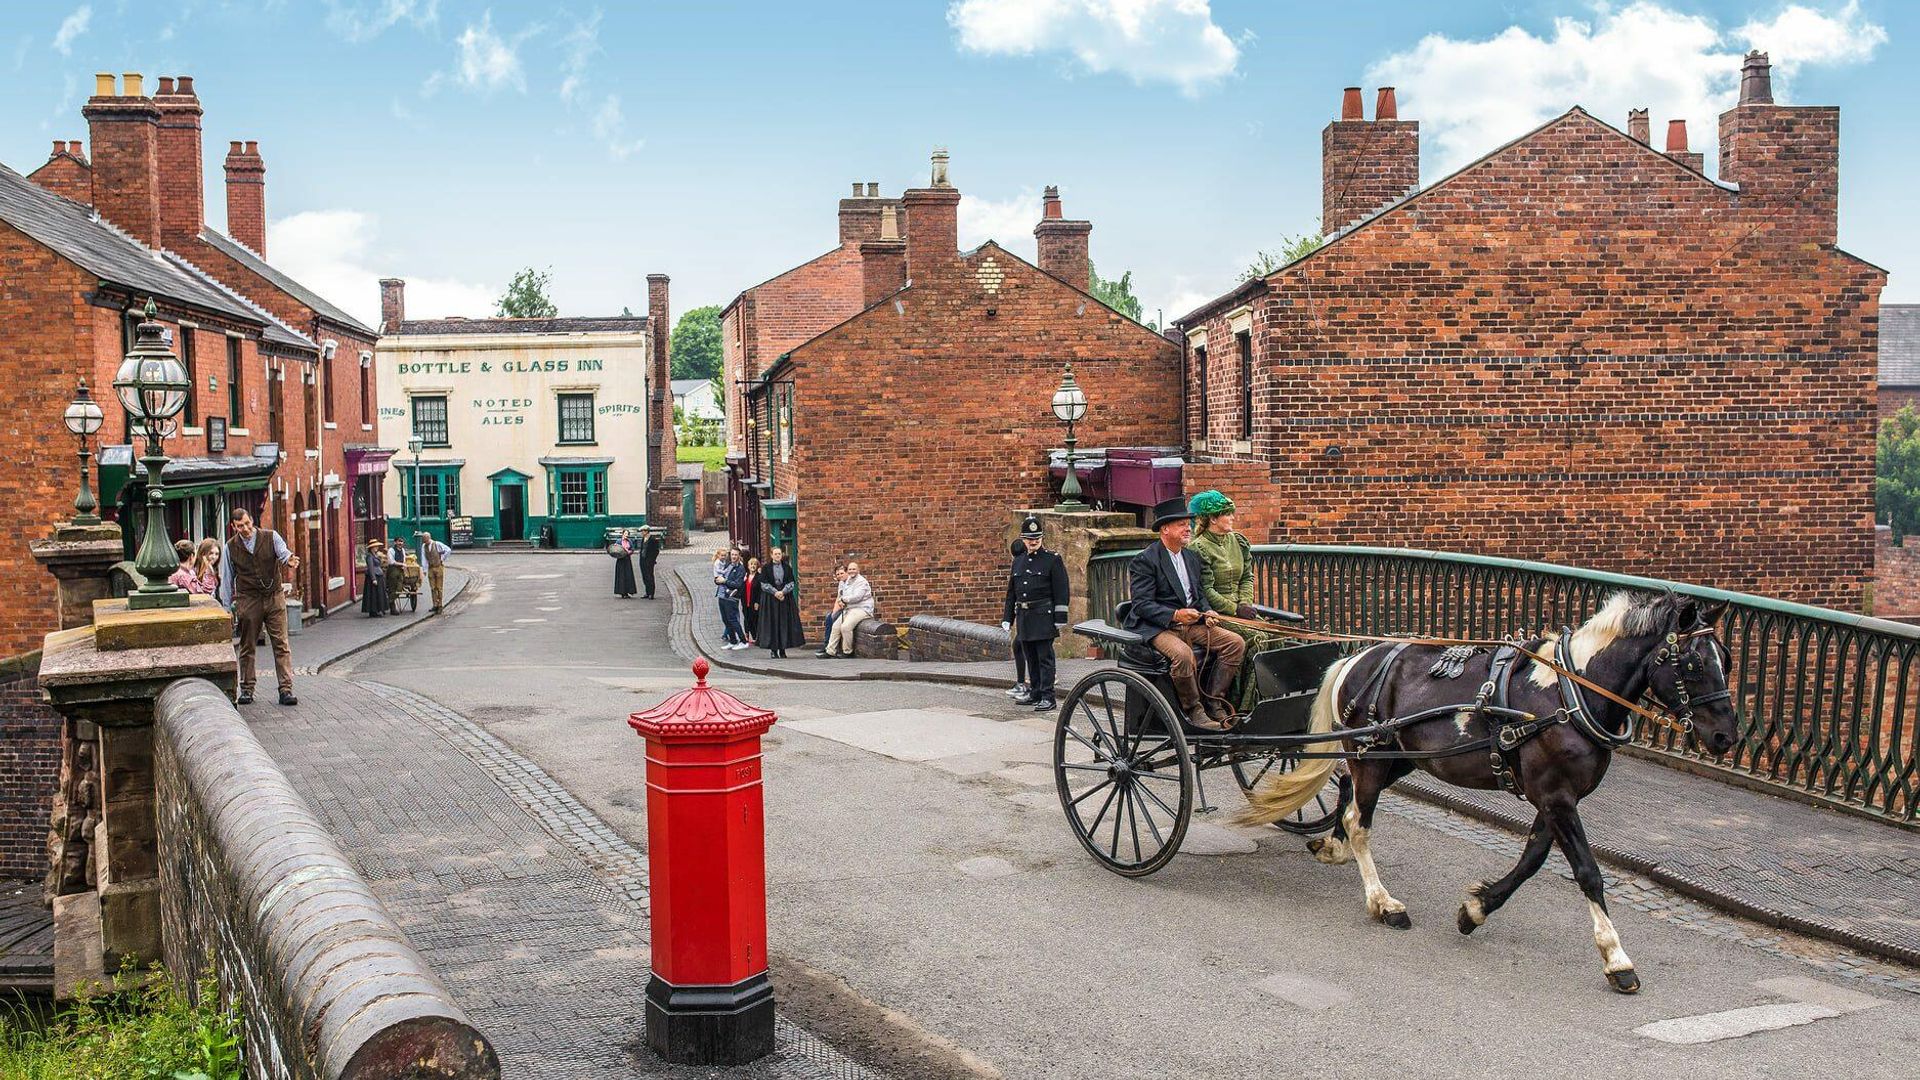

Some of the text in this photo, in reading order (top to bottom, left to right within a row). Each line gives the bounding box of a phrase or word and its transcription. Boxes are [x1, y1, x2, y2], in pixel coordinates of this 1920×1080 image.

[398, 360, 603, 374] BOTTLE & GLASS INN
[473, 399, 533, 407] NOTED
[377, 407, 405, 416] INES
[598, 404, 641, 415] SPIRITS
[482, 416, 524, 425] ALES
